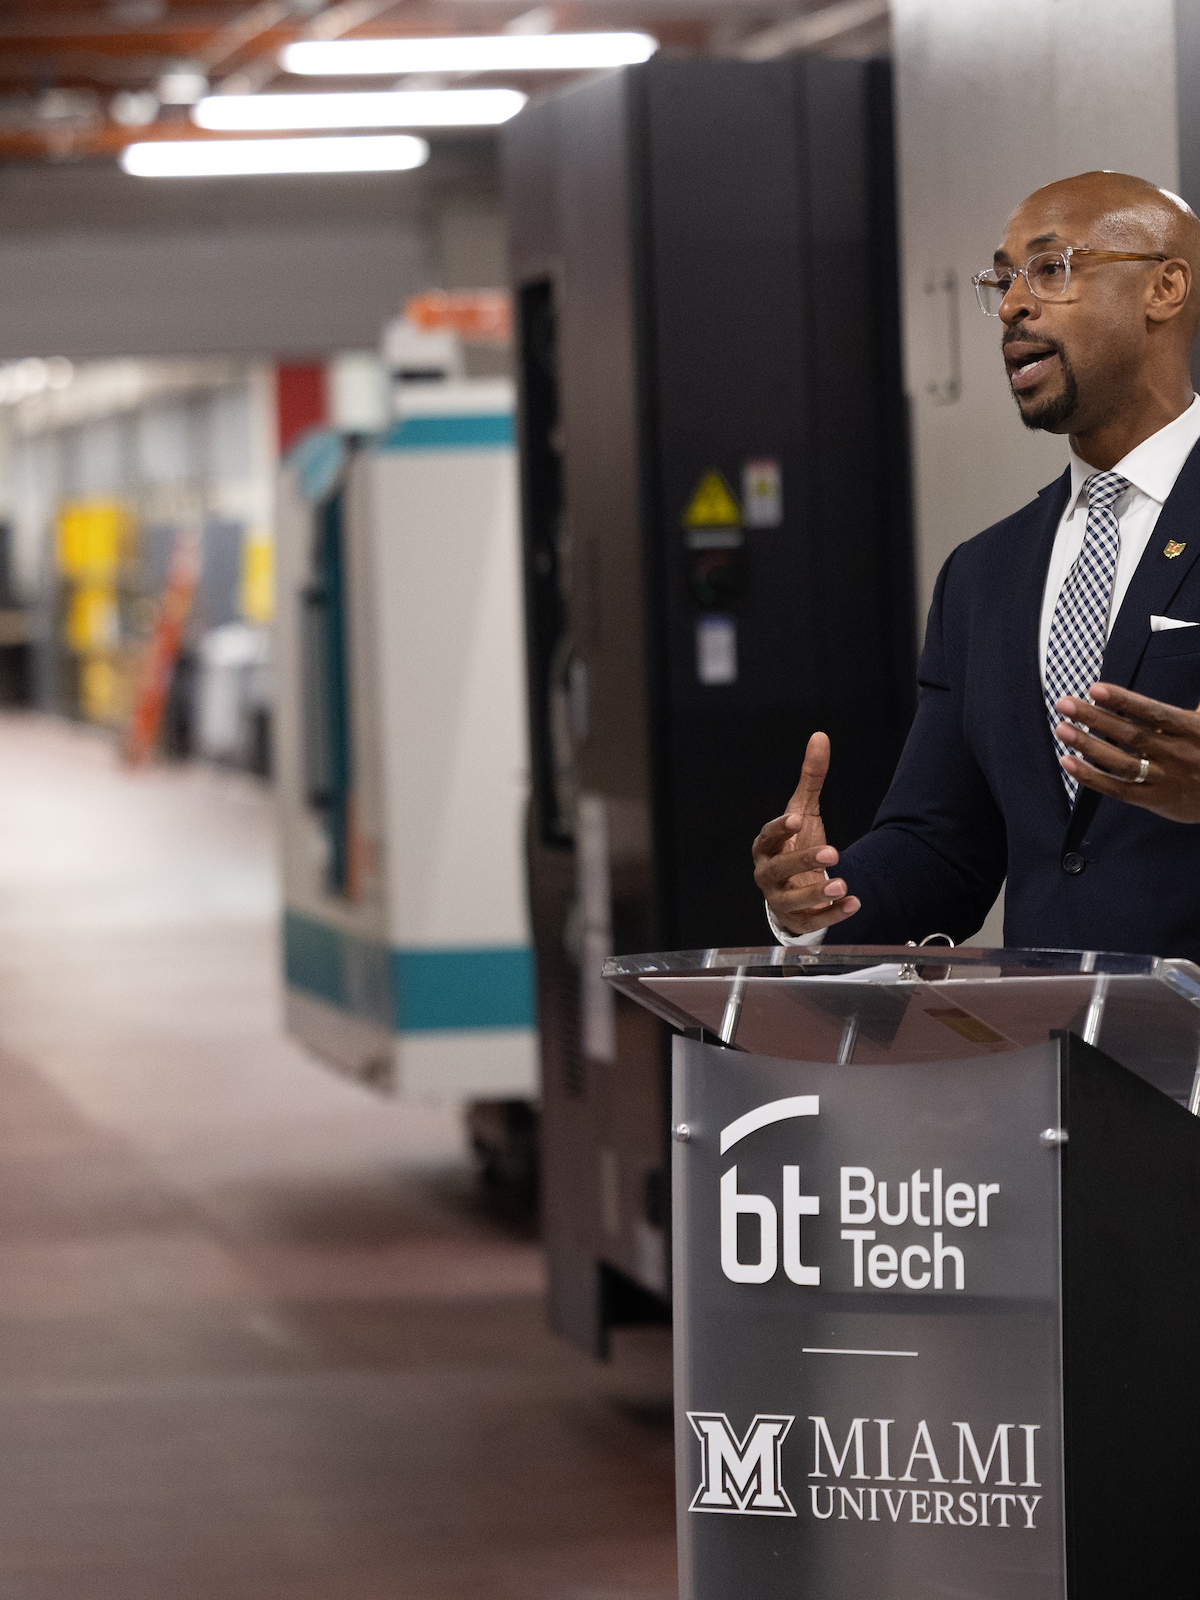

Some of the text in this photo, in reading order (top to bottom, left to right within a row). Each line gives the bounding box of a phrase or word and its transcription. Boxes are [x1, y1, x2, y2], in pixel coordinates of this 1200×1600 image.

[720, 1165, 821, 1286] bt
[839, 1166, 1000, 1228] Butler
[839, 1229, 966, 1291] Tech
[686, 1411, 797, 1518] M
[807, 1415, 1043, 1488] MIAMI
[807, 1484, 1043, 1529] UNIVERSITY
